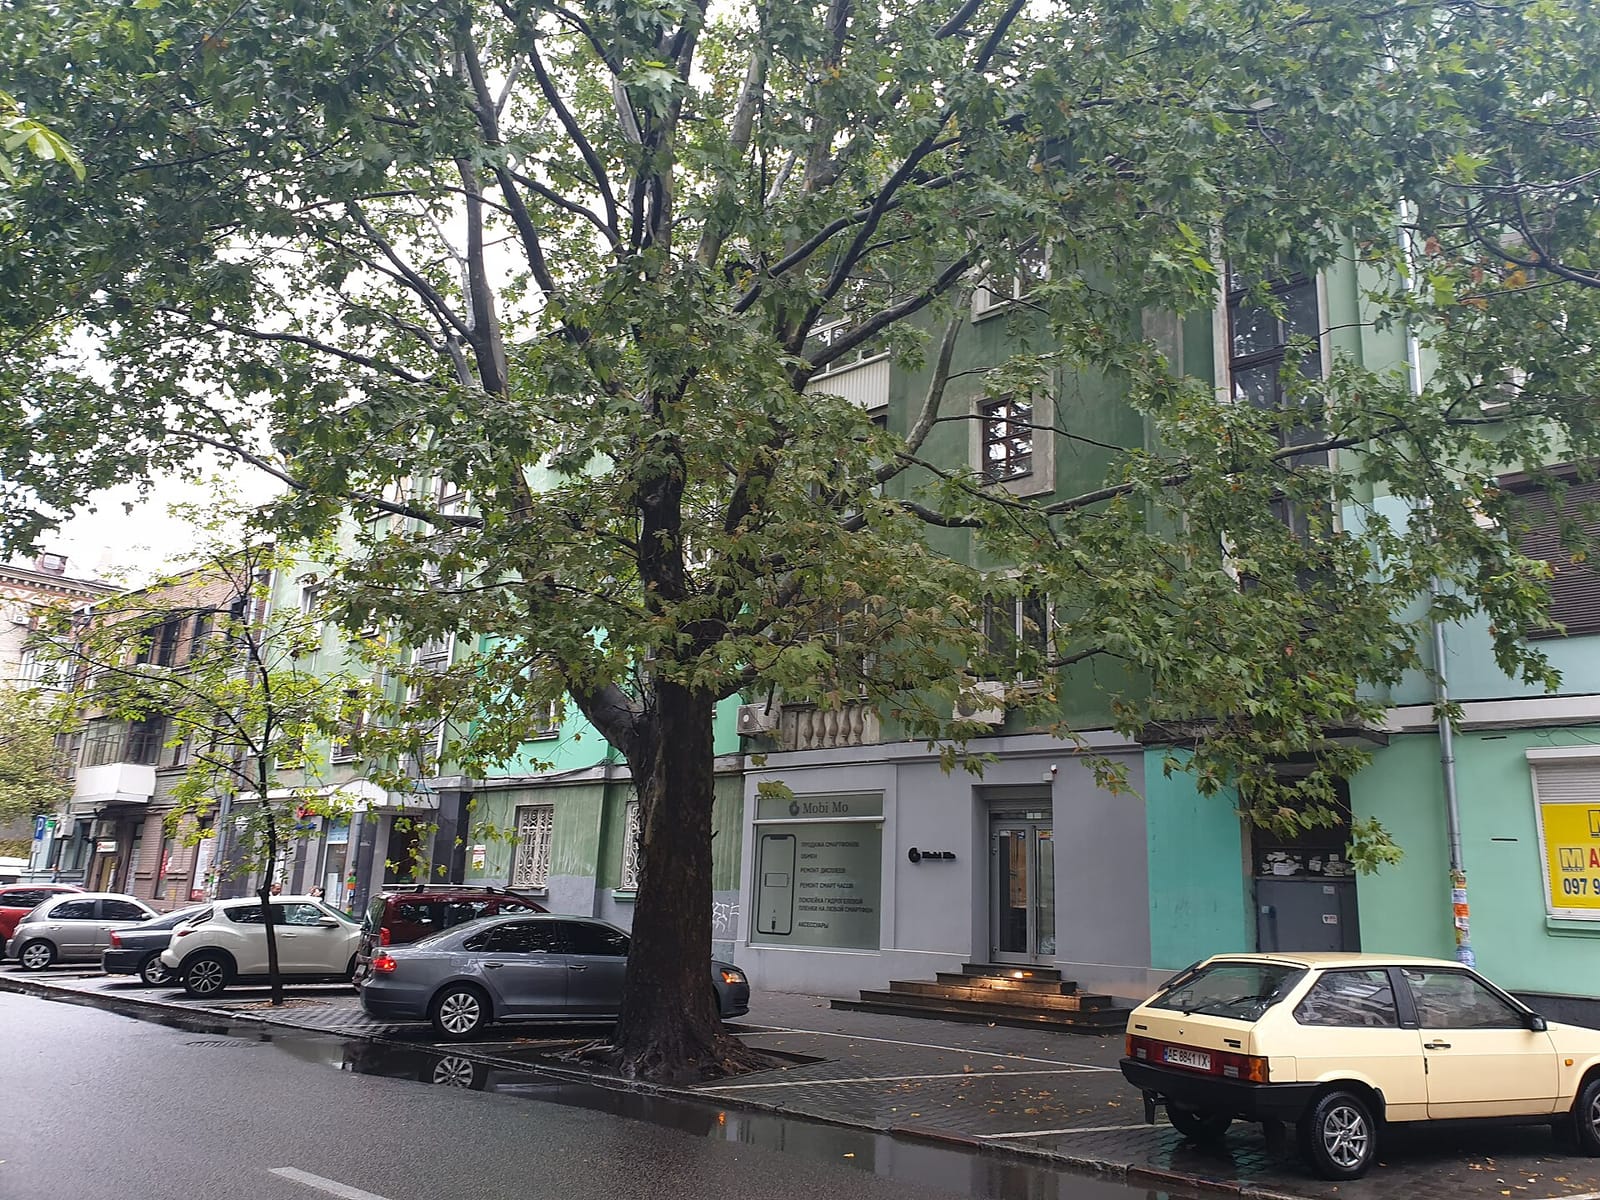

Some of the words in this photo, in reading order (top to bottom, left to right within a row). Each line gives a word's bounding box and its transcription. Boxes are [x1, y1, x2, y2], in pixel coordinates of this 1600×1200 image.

[802, 802, 829, 814] Mobi
[832, 801, 849, 813] Mo
[36, 818, 44, 838] P
[1563, 878, 1587, 895] 097
[1168, 1049, 1178, 1061] AE
